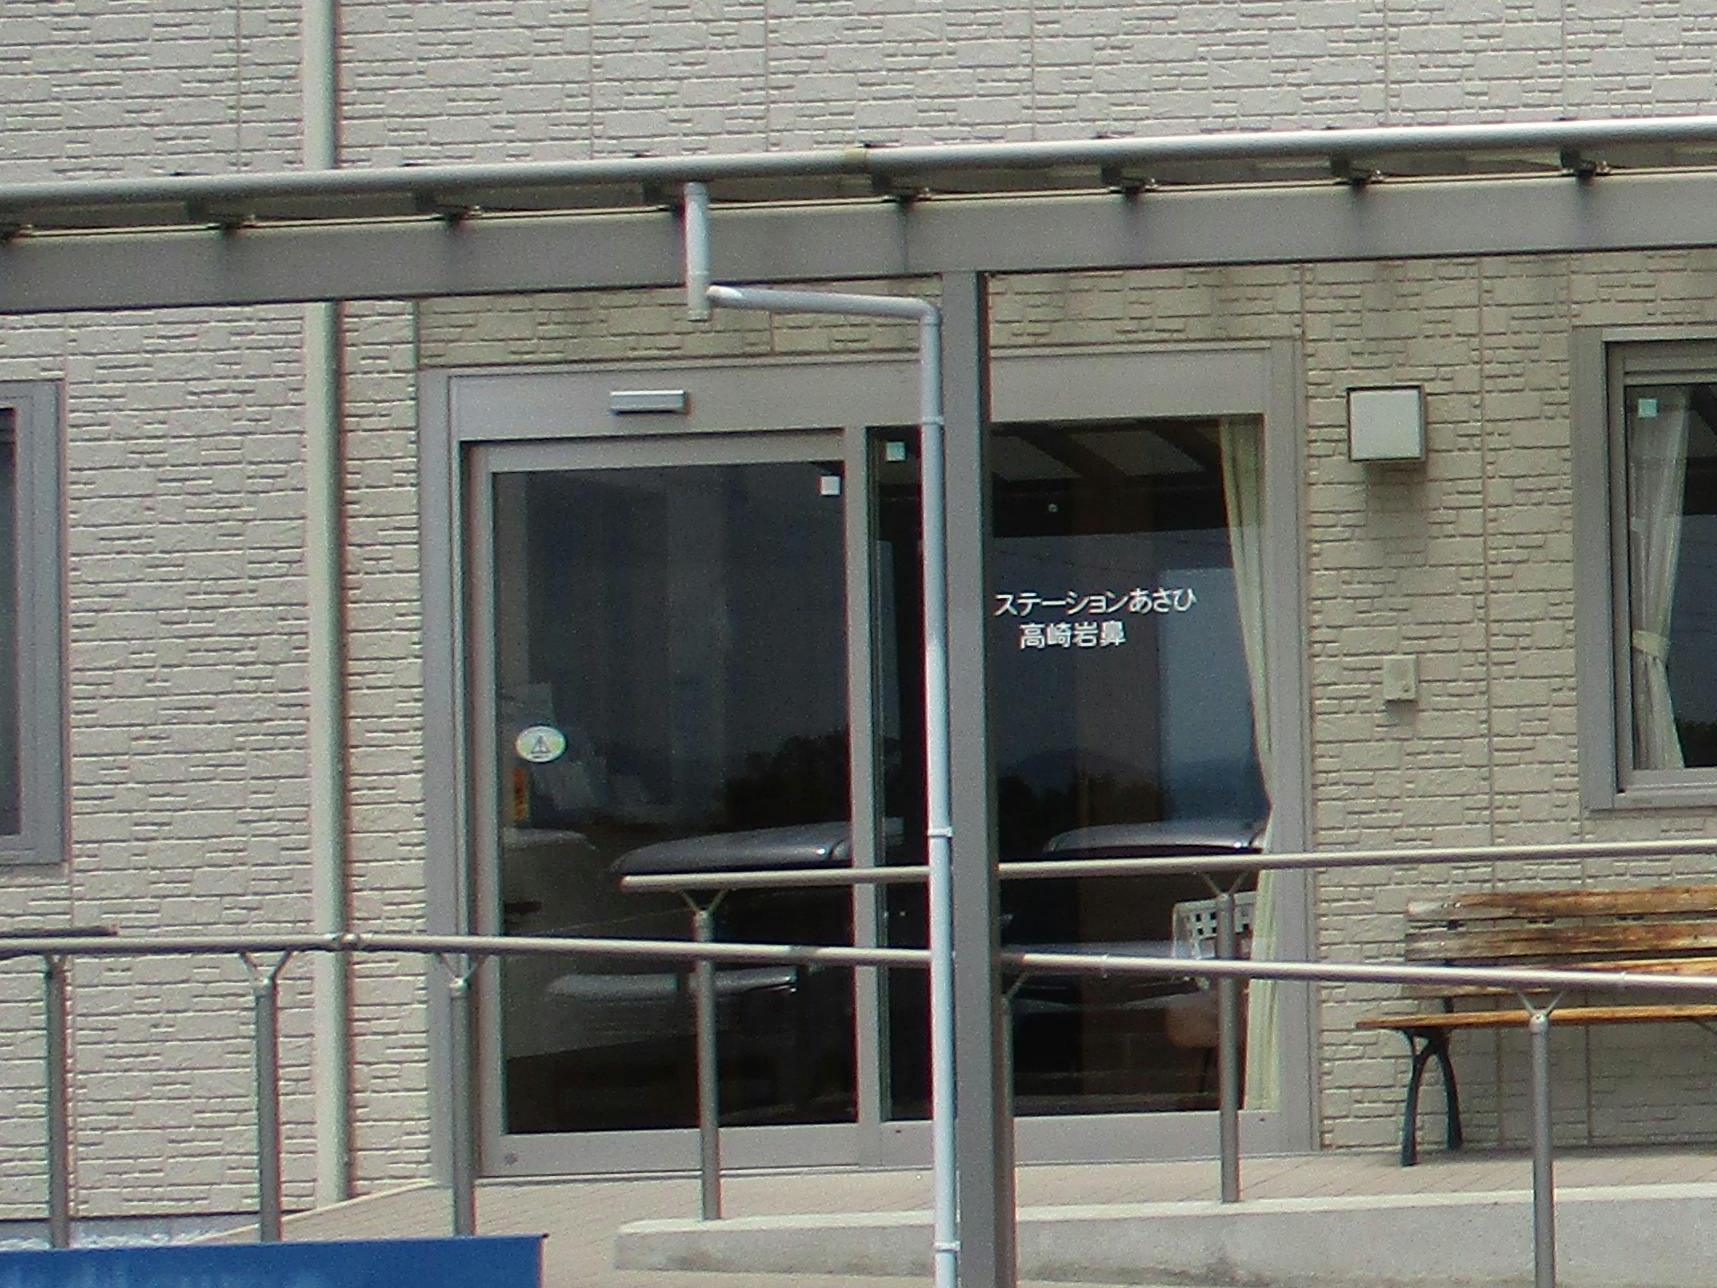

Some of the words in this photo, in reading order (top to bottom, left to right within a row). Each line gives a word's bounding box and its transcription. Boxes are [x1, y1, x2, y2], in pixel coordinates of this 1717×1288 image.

[994, 587, 1197, 617] ステーションあさひ
[1019, 620, 1127, 650] 高崎岩鼻
